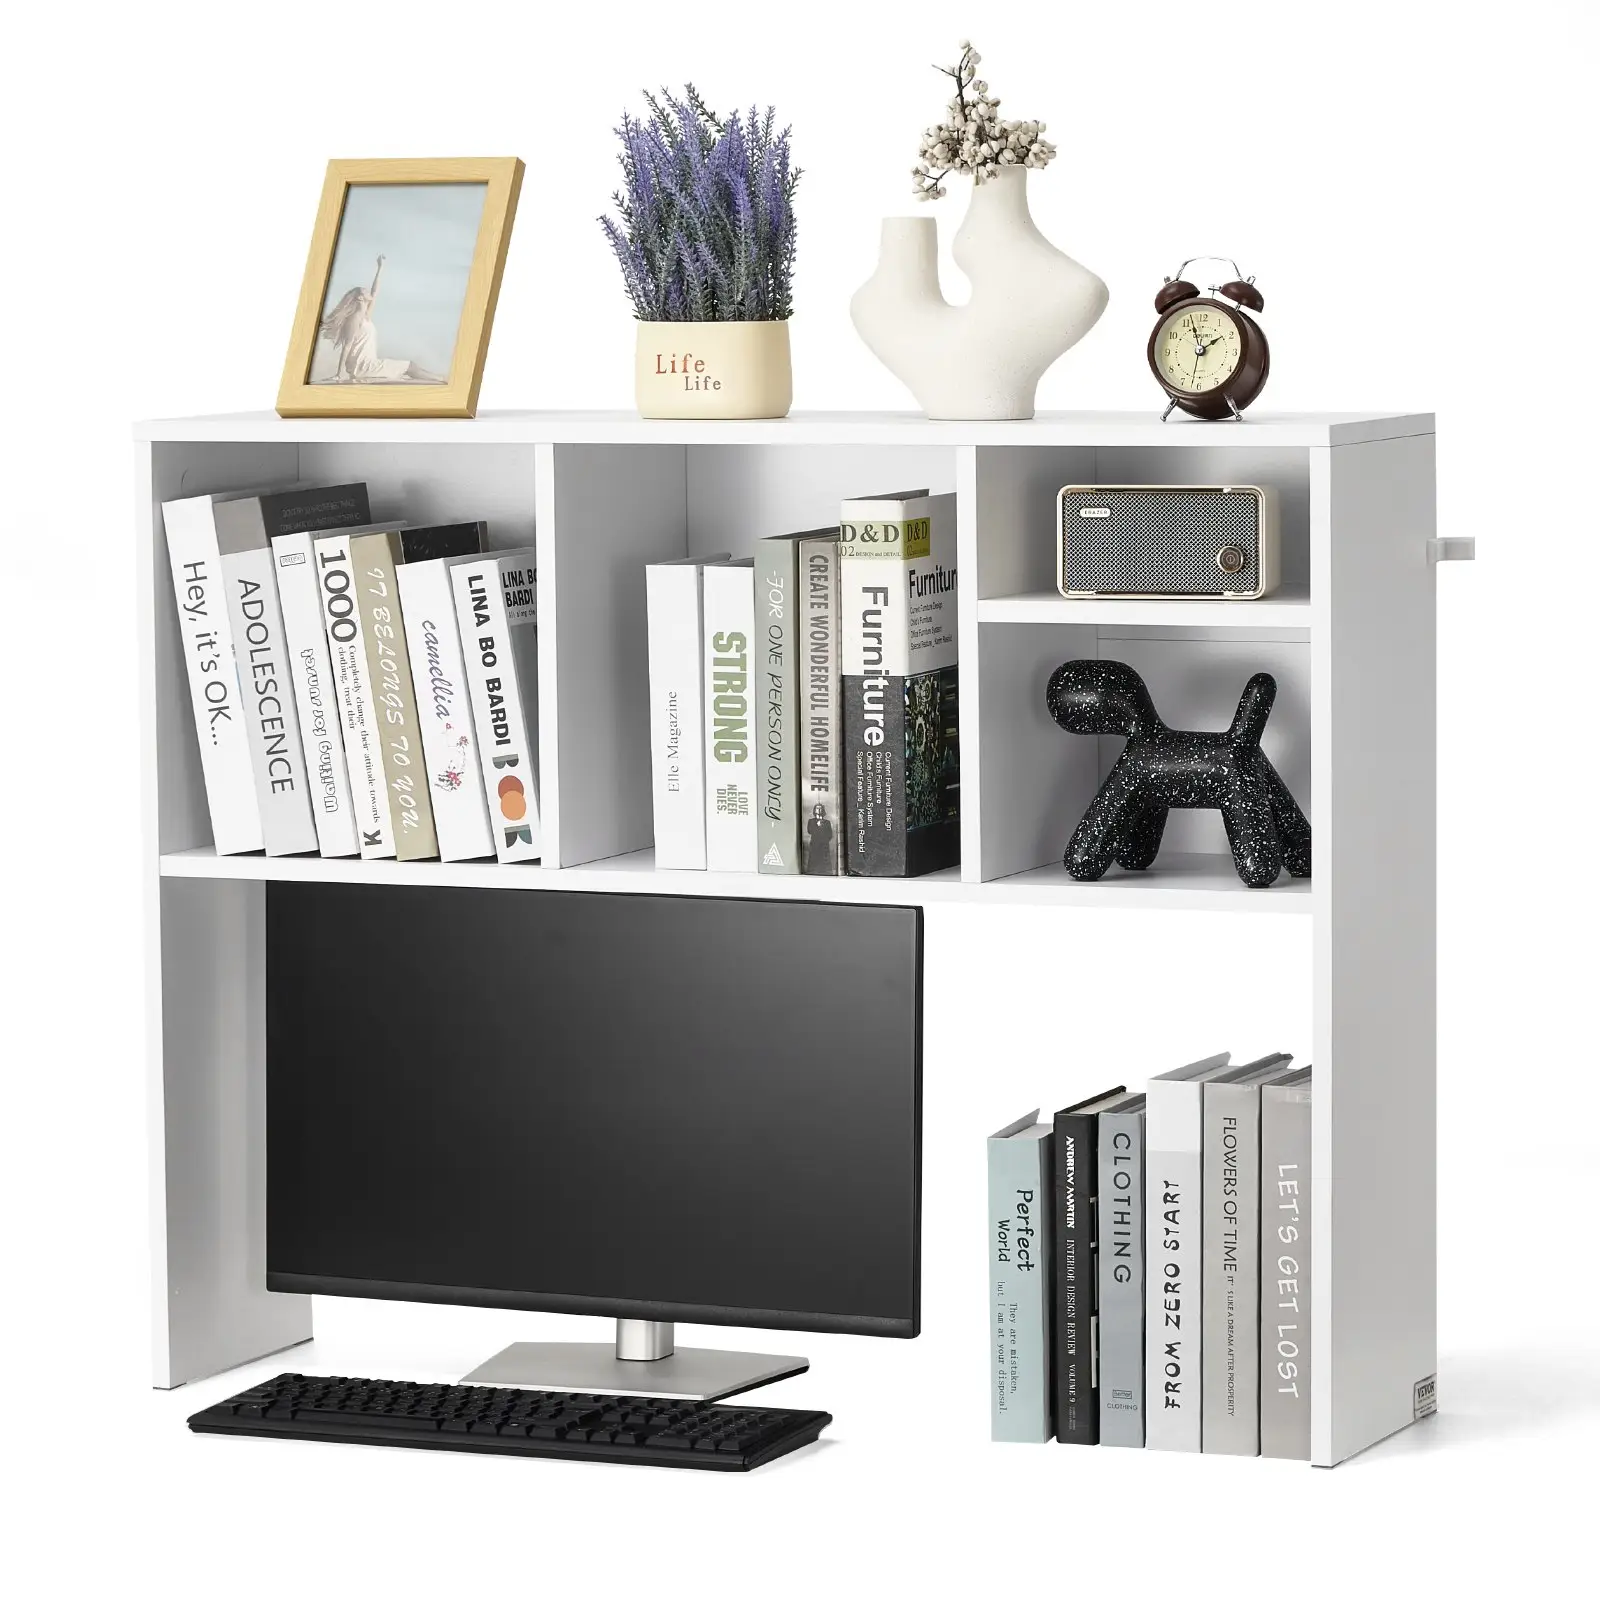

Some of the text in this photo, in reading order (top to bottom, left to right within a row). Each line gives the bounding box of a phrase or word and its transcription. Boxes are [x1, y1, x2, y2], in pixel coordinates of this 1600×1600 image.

[1182, 319, 1190, 327] 11
[656, 353, 705, 374] Life
[1169, 365, 1174, 373] 8
[1227, 365, 1232, 373] 4
[1232, 348, 1238, 356] 3
[684, 376, 721, 391] Life
[1196, 382, 1201, 390] 6
[320, 549, 357, 643] 1000
[368, 567, 388, 598] IT
[502, 570, 525, 588] LINA
[505, 588, 534, 607] BARDI
[909, 565, 957, 598] Furnitur
[183, 561, 232, 746] Hey, it's OK...
[467, 574, 511, 746] LINA BO BARDI
[768, 624, 783, 666] ONE
[338, 647, 348, 684] clothing,
[373, 606, 404, 726] BELONGS
[422, 620, 453, 720] camellia
[809, 555, 829, 793] CREATE WONDERFUL HOMELIFE
[862, 586, 889, 747] Furniture
[238, 578, 295, 794] ADOLESCENCE
[712, 631, 748, 763] STRONG
[301, 649, 338, 813] Waiting for sunset
[349, 645, 360, 694] Completely
[356, 696, 365, 727] change
[364, 753, 375, 787] attitude
[370, 788, 380, 823] towards
[767, 673, 783, 761] PERSON
[390, 735, 411, 766] TO
[668, 691, 681, 793] Elle Magazine
[856, 751, 864, 775] Special
[716, 788, 727, 814] DIES.
[727, 784, 738, 815] NEVER
[738, 792, 749, 816] LOVE
[884, 808, 893, 831] Design
[1066, 1135, 1075, 1185] ANDREW
[1223, 1117, 1237, 1197] FLOWERS
[1066, 1186, 1075, 1229] MARTIN
[1113, 1132, 1131, 1284] CLOTHING
[1223, 1200, 1237, 1225] OF
[998, 1219, 1010, 1263] World
[1016, 1189, 1034, 1272] Perfect
[1066, 1239, 1075, 1282] INTERIOR
[1223, 1231, 1237, 1272] TIME
[997, 1281, 1005, 1297] but
[1163, 1179, 1181, 1409] FROM ZERO START
[1277, 1164, 1299, 1398] LET'S GET LOST
[998, 1312, 1003, 1324] am
[1009, 1302, 1018, 1324] They
[1066, 1286, 1075, 1318] DESIGN
[998, 1328, 1004, 1339] at
[1066, 1322, 1075, 1356] REVIEW
[1010, 1348, 1018, 1394] mistaken,
[1068, 1363, 1076, 1396] VOLUME
[997, 1369, 1007, 1414] disposal.
[1106, 1402, 1138, 1411] CLOTHING
[1227, 1372, 1235, 1416] PROSPERITY
